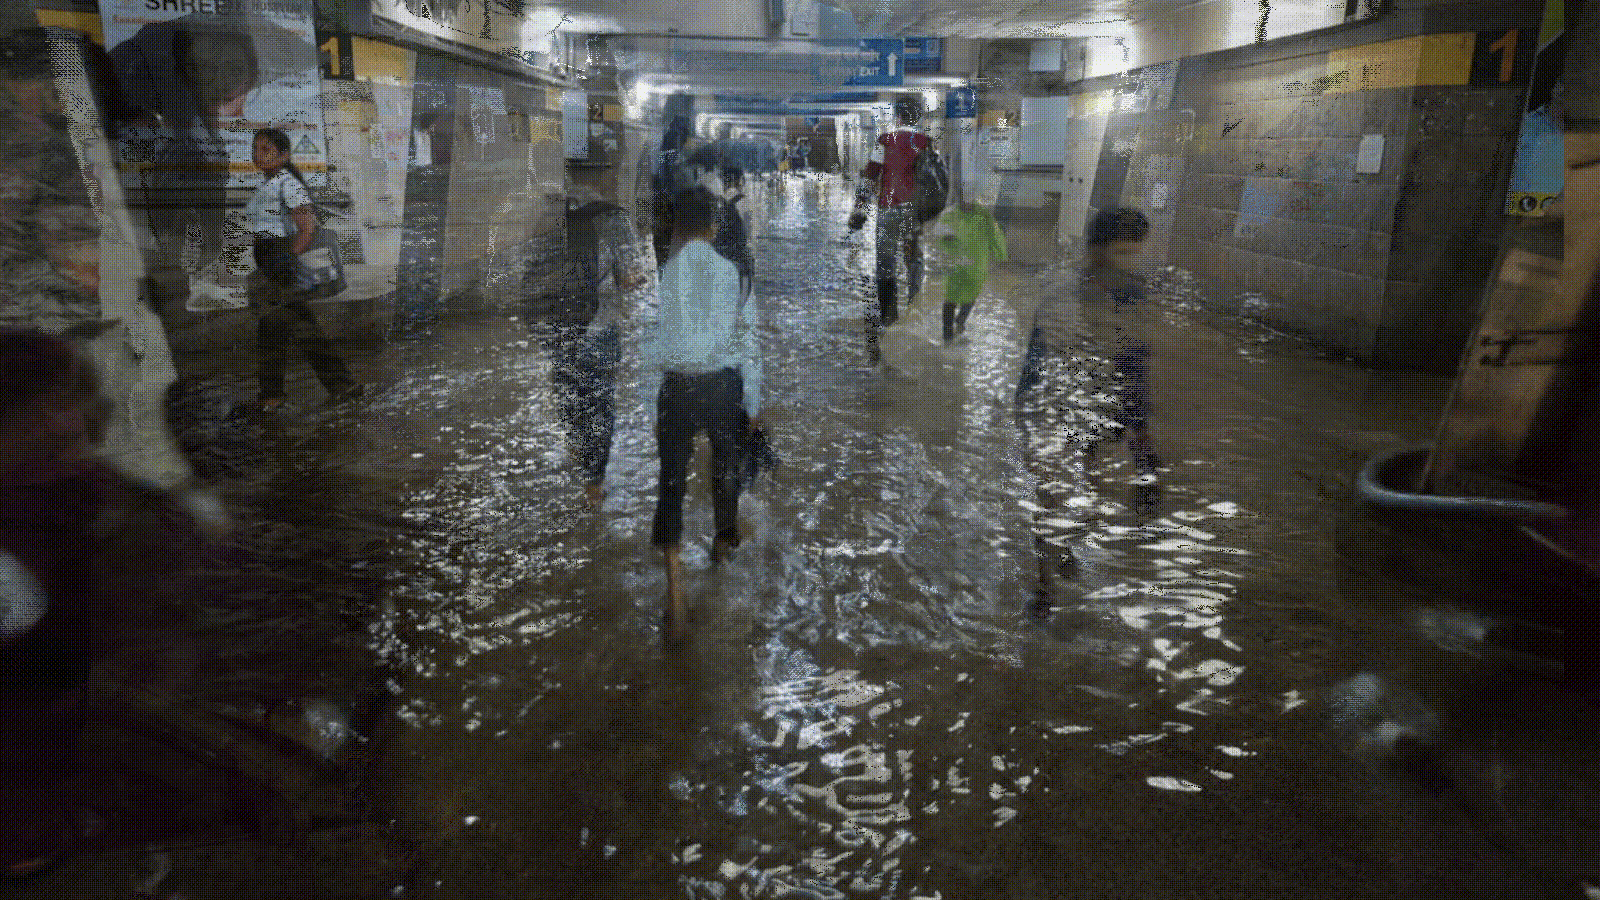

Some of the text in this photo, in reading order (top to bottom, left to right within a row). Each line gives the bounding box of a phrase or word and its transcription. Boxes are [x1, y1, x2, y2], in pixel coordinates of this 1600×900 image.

[320, 37, 341, 76] 1
[859, 66, 880, 77] EXIT
[1489, 28, 1519, 83] 1
